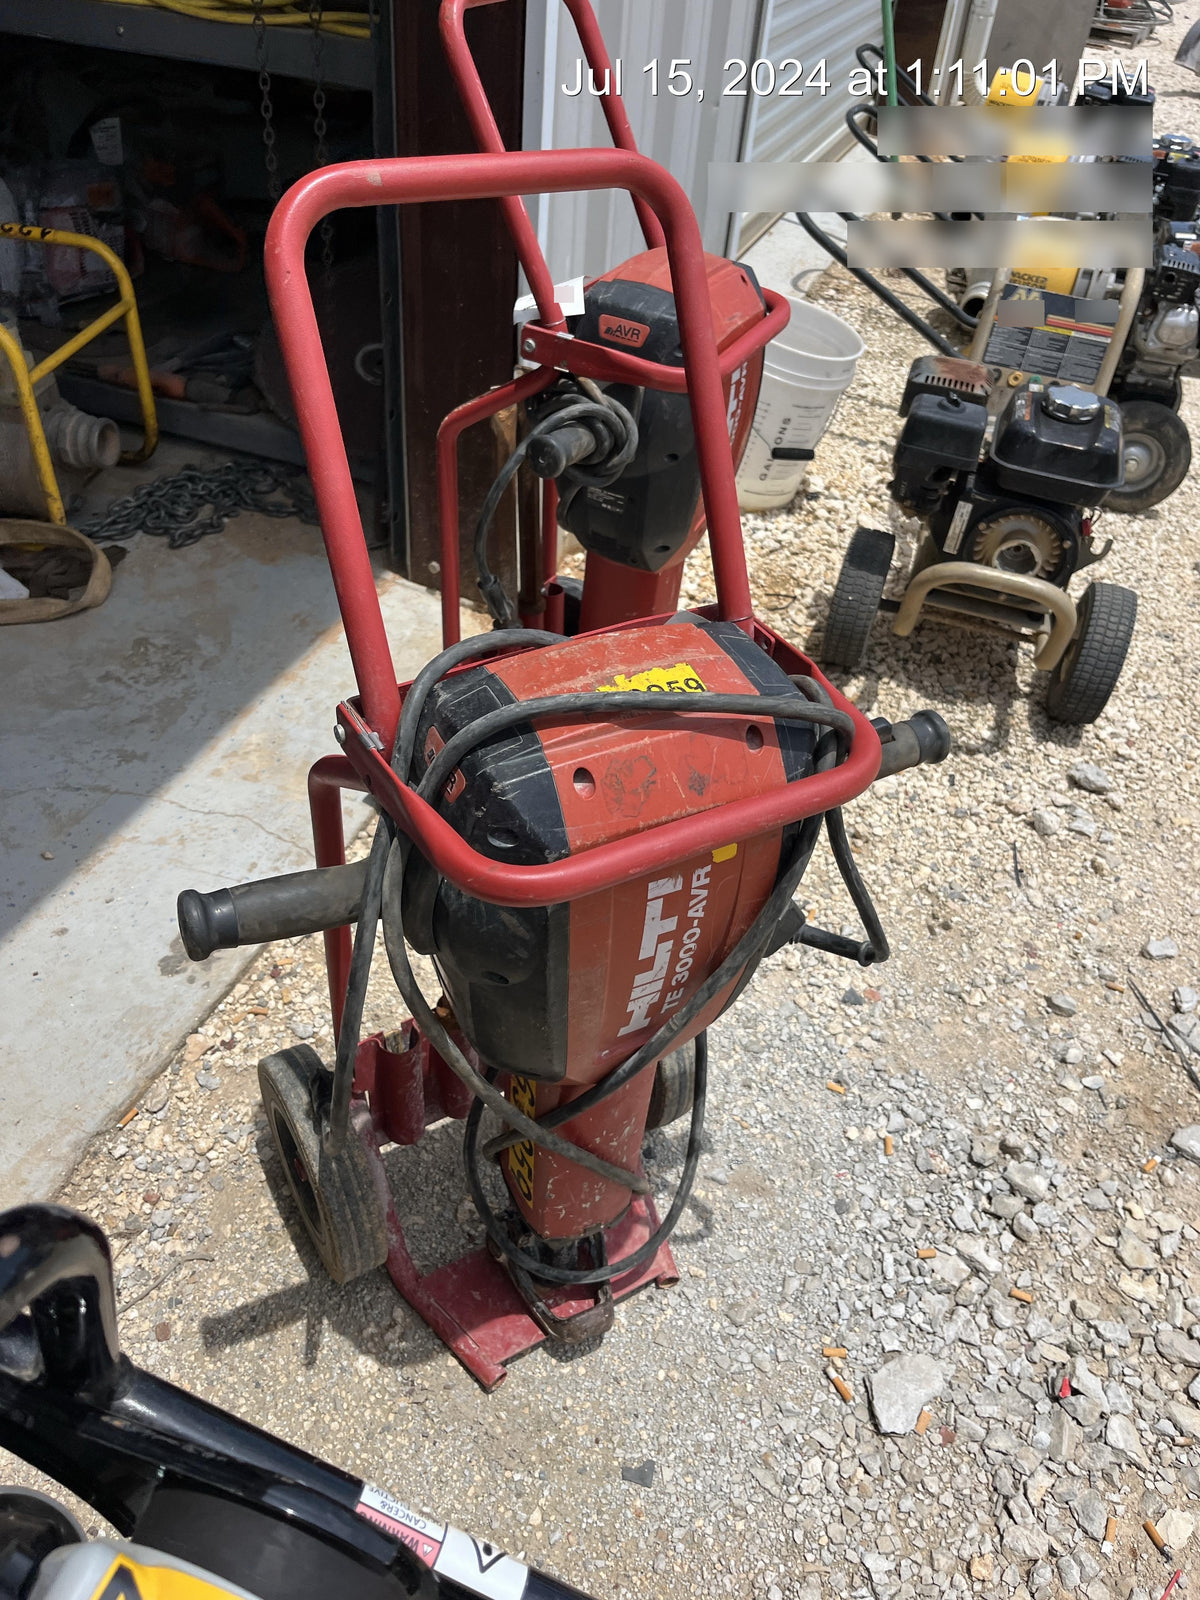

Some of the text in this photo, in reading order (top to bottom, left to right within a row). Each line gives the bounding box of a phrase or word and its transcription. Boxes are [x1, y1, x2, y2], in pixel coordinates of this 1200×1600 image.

[614, 323, 642, 341] AVR
[758, 417, 792, 481] GAONS
[617, 873, 684, 1038] HILTI
[660, 864, 712, 1014] TE 3000-AVR
